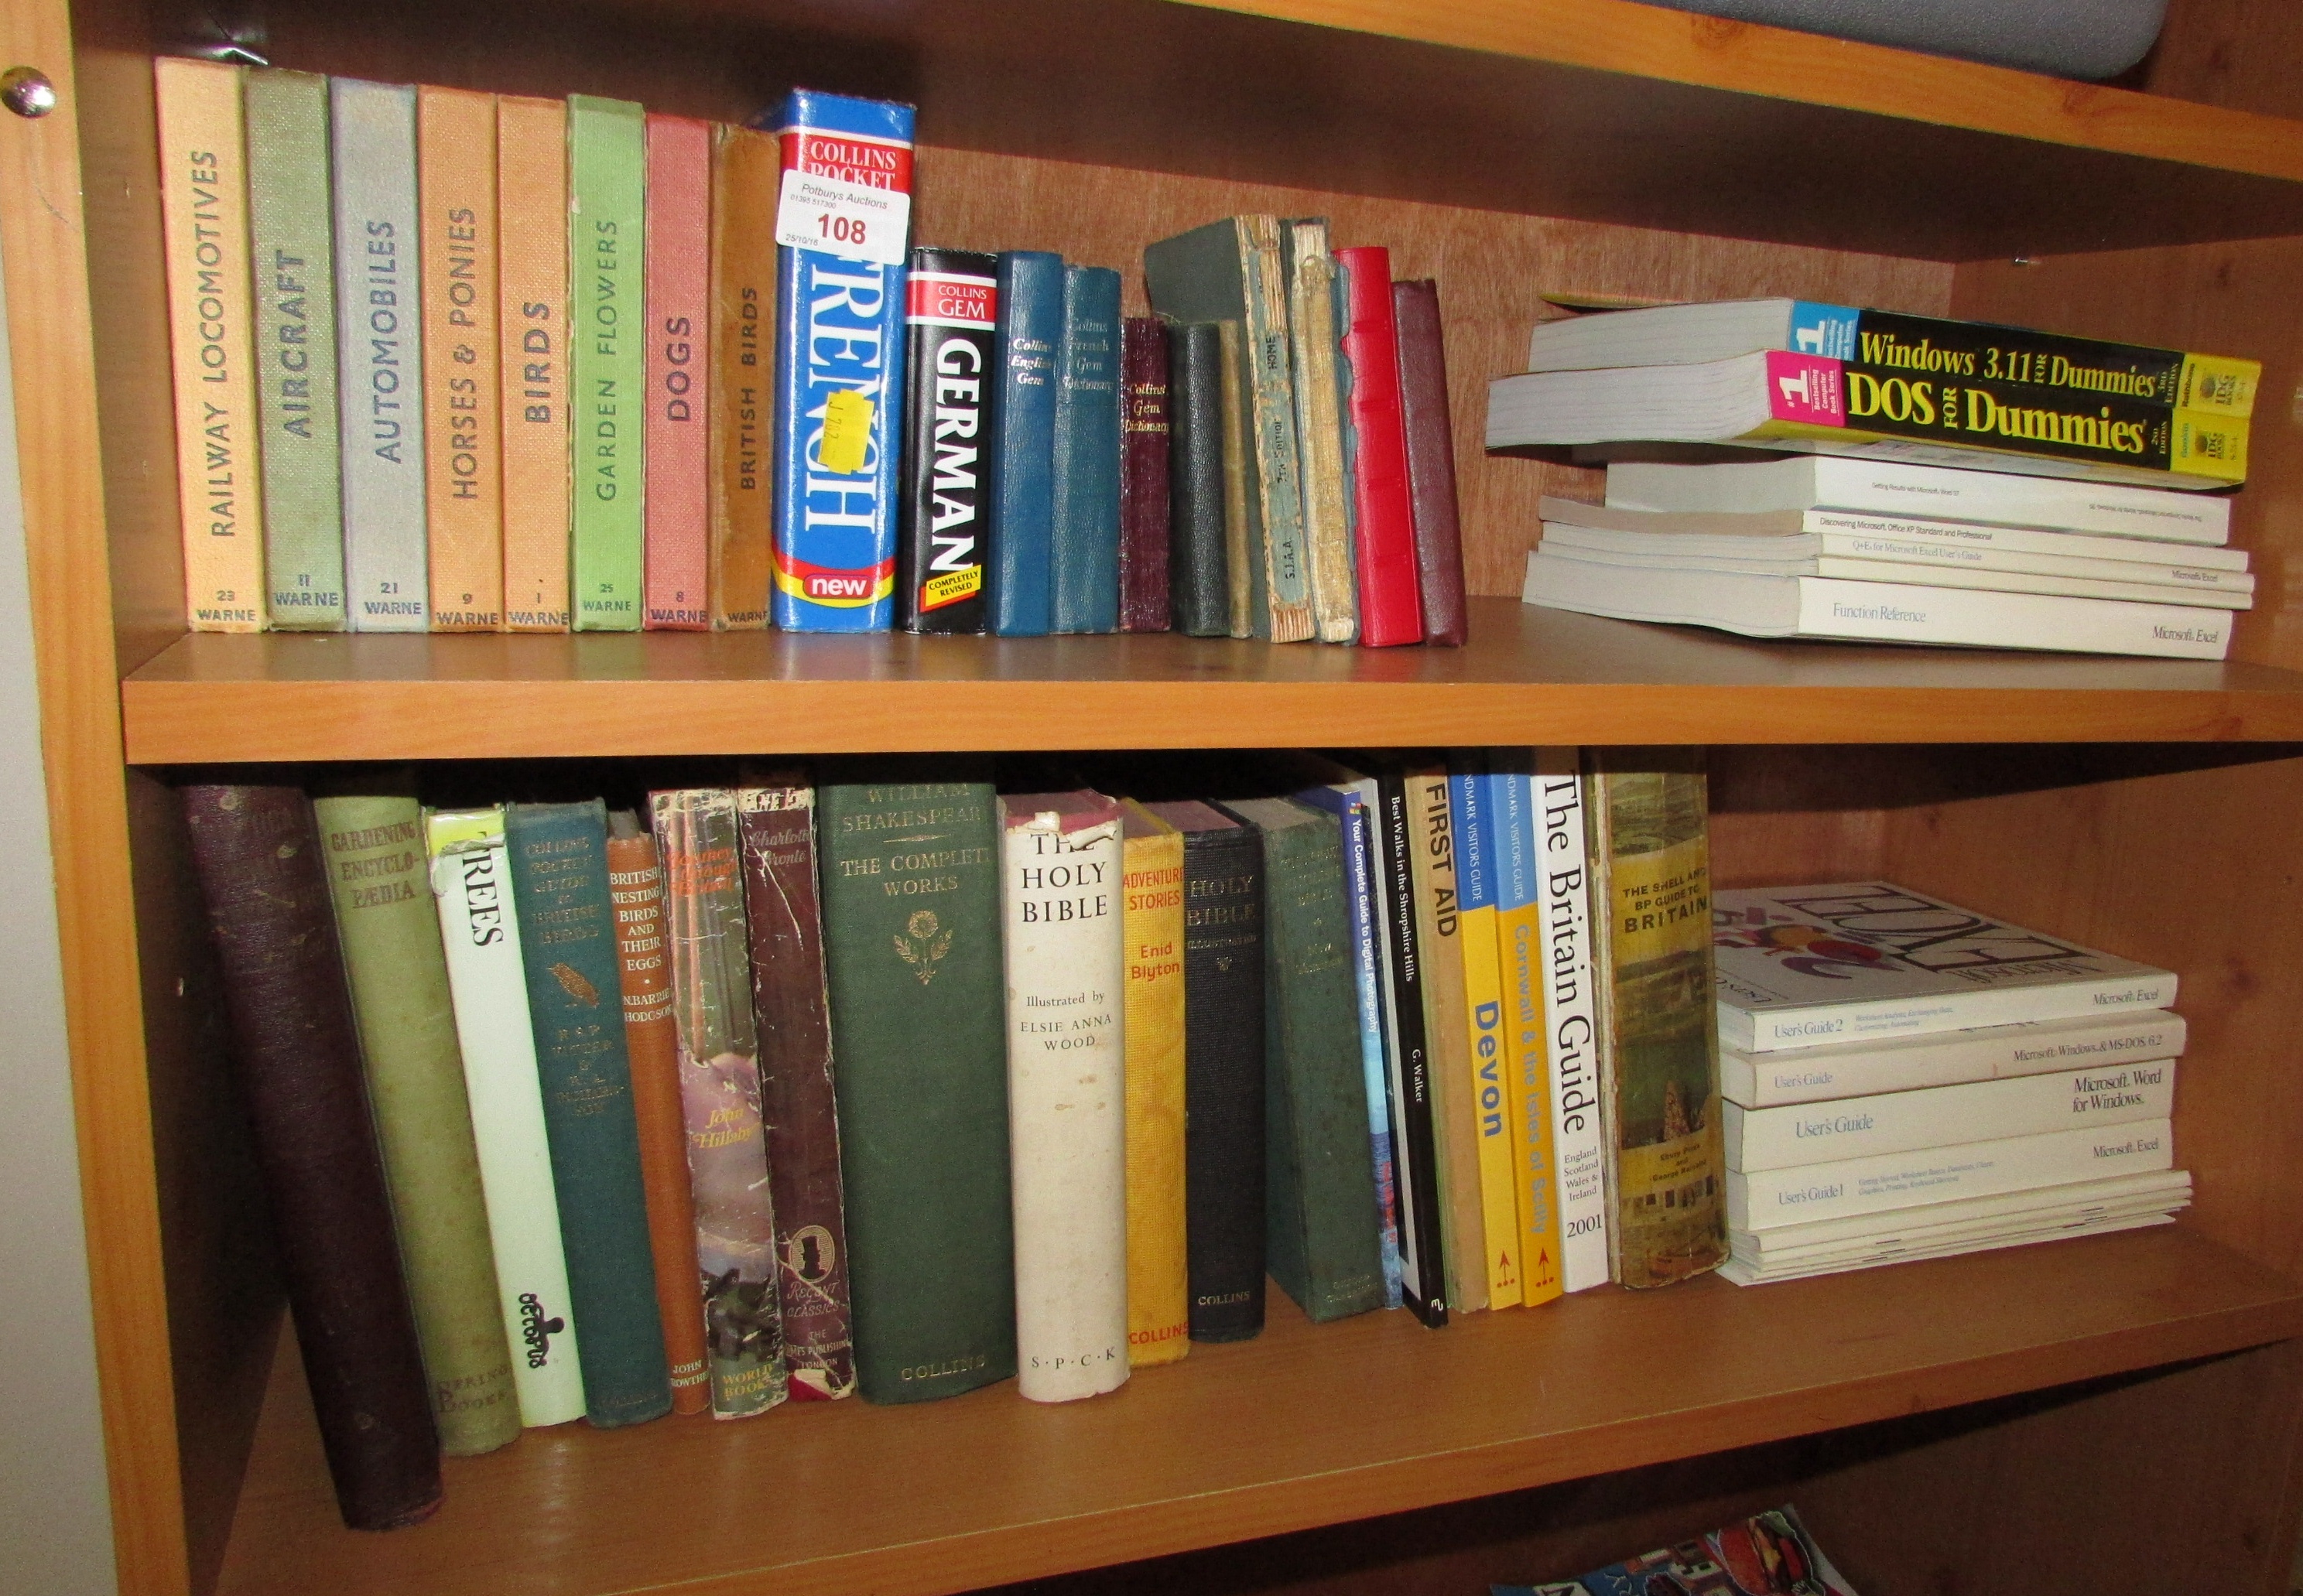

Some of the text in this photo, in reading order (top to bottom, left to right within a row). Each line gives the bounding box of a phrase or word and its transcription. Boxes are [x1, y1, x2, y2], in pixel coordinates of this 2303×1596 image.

[810, 141, 897, 170] COLLINS
[809, 162, 895, 191] POCKET
[790, 194, 837, 209] 01395 517300
[802, 183, 888, 210] Potburys Auctions
[818, 213, 866, 244] 108
[785, 234, 819, 246] 25/10/16
[938, 285, 987, 299] COLLINS
[938, 299, 985, 320] GEM
[1072, 318, 1108, 333] Collins
[191, 151, 235, 537] RAILWAY LOCOMOTIVES
[276, 250, 312, 439] AIRCRAFT
[368, 220, 402, 464] AUTOMOBILES
[448, 208, 478, 500] HORSES & PONIES
[523, 302, 551, 423] BIRDS
[596, 220, 618, 501] GARDEN FLOWERS
[1268, 336, 1278, 371] HOME
[666, 316, 691, 422] DOGS
[1076, 357, 1103, 373] Gem
[1860, 331, 2156, 398] Windows 3.11 FOR Dummies
[741, 287, 758, 490] BRITISH BIRDS
[1016, 373, 1045, 386] Gem
[1063, 377, 1114, 393] Dictionary
[1128, 384, 1165, 396] Collins
[1812, 369, 1821, 411] Bestselling
[1827, 370, 1836, 395] Series
[2164, 362, 2179, 403] EDITION
[1133, 402, 1161, 416] Gem
[1846, 371, 1935, 425] DOS
[1942, 388, 1959, 429] FOR
[1964, 388, 2144, 454] Dummies
[1124, 419, 1169, 435] Dictionary
[2159, 421, 2168, 455] EDITION
[929, 339, 981, 571] GERMAN
[1820, 517, 1856, 530] Discovering
[1887, 524, 1906, 533] Office
[1915, 527, 1944, 537] Standard
[1956, 530, 1993, 541] Professional
[381, 582, 399, 594] 21
[812, 573, 866, 596] new
[929, 570, 979, 591] COMPLETELY
[939, 582, 973, 597] REVISED
[217, 590, 235, 602] 23
[274, 592, 339, 608] WARNE
[462, 593, 473, 604] 9
[582, 600, 631, 612] WARNE
[676, 591, 684, 603] 8
[197, 609, 258, 622] WARNE
[364, 601, 423, 617] WARNE
[436, 611, 498, 626] WARNE
[507, 611, 569, 626] WARNE
[651, 610, 708, 623] WARNE
[1832, 602, 1927, 624] Function Reference
[1391, 796, 1401, 819] Best
[330, 822, 416, 852] GARDENING
[1394, 822, 1403, 857] Walks
[1466, 822, 1480, 866] VISITORS
[1510, 822, 1521, 866] VISITORS
[840, 857, 881, 877] THE
[1396, 859, 1403, 871] in
[1425, 783, 1457, 937] FIRST AID
[610, 867, 658, 886] BRITISH
[1021, 861, 1107, 889] HOLY
[1124, 866, 1184, 889] ADVENTURE
[1470, 868, 1482, 901] GUIDE
[1513, 868, 1524, 901] GUIDE
[1622, 866, 1706, 899] THE SHELL AND
[611, 887, 660, 904] NESTING
[884, 876, 959, 897] WORKS
[1190, 875, 1254, 897] HOLY
[1129, 890, 1180, 912] STORIES
[1635, 883, 1700, 911] BP GUIDE TO
[619, 906, 659, 923] BIRDS
[1021, 894, 1107, 924] BIBLE
[1187, 904, 1257, 926] BIBLE
[1624, 896, 1709, 934] BRITAIN
[628, 923, 655, 937] AND
[1352, 819, 1379, 1033] Your Complete Guide to Digital Photography
[1399, 893, 1410, 953] Shropshire
[621, 937, 661, 954] THEIR
[1141, 942, 1173, 959] Enid
[1545, 772, 1596, 1135] The Britain Guide
[627, 955, 662, 972] EGGS
[1131, 962, 1180, 982] Blyton
[1405, 955, 1414, 983] Hills
[1026, 991, 1105, 1007] Illustrated by
[1020, 1014, 1112, 1033] ELSIE ANNA
[1774, 1023, 1803, 1039] User's
[1805, 1020, 1835, 1036] Guide
[1835, 1019, 1843, 1032] 2
[1044, 1036, 1096, 1051] WOOD
[1411, 1048, 1423, 1102] G. Walker
[1474, 1000, 1504, 1137] Devon
[2133, 1068, 2162, 1086] Word
[1774, 1071, 1833, 1089] User's Guide
[2072, 1098, 2089, 1112] for
[705, 1108, 744, 1129] John
[1795, 1113, 1874, 1140] User's Guide
[1563, 1147, 1597, 1164] England
[2137, 1138, 2160, 1152] Excel
[1564, 1159, 1599, 1177] Scotland
[1566, 1174, 1598, 1189] Wales &
[1569, 1186, 1597, 1202] Ireland
[1566, 1214, 1602, 1239] 2001
[786, 1300, 839, 1317] CLASSICS
[1198, 1290, 1251, 1307] COLLINS
[809, 1328, 827, 1339] THE
[1128, 1321, 1189, 1345] COLLINS
[673, 1360, 702, 1374] JOHN
[902, 1354, 985, 1381] COLLINS
